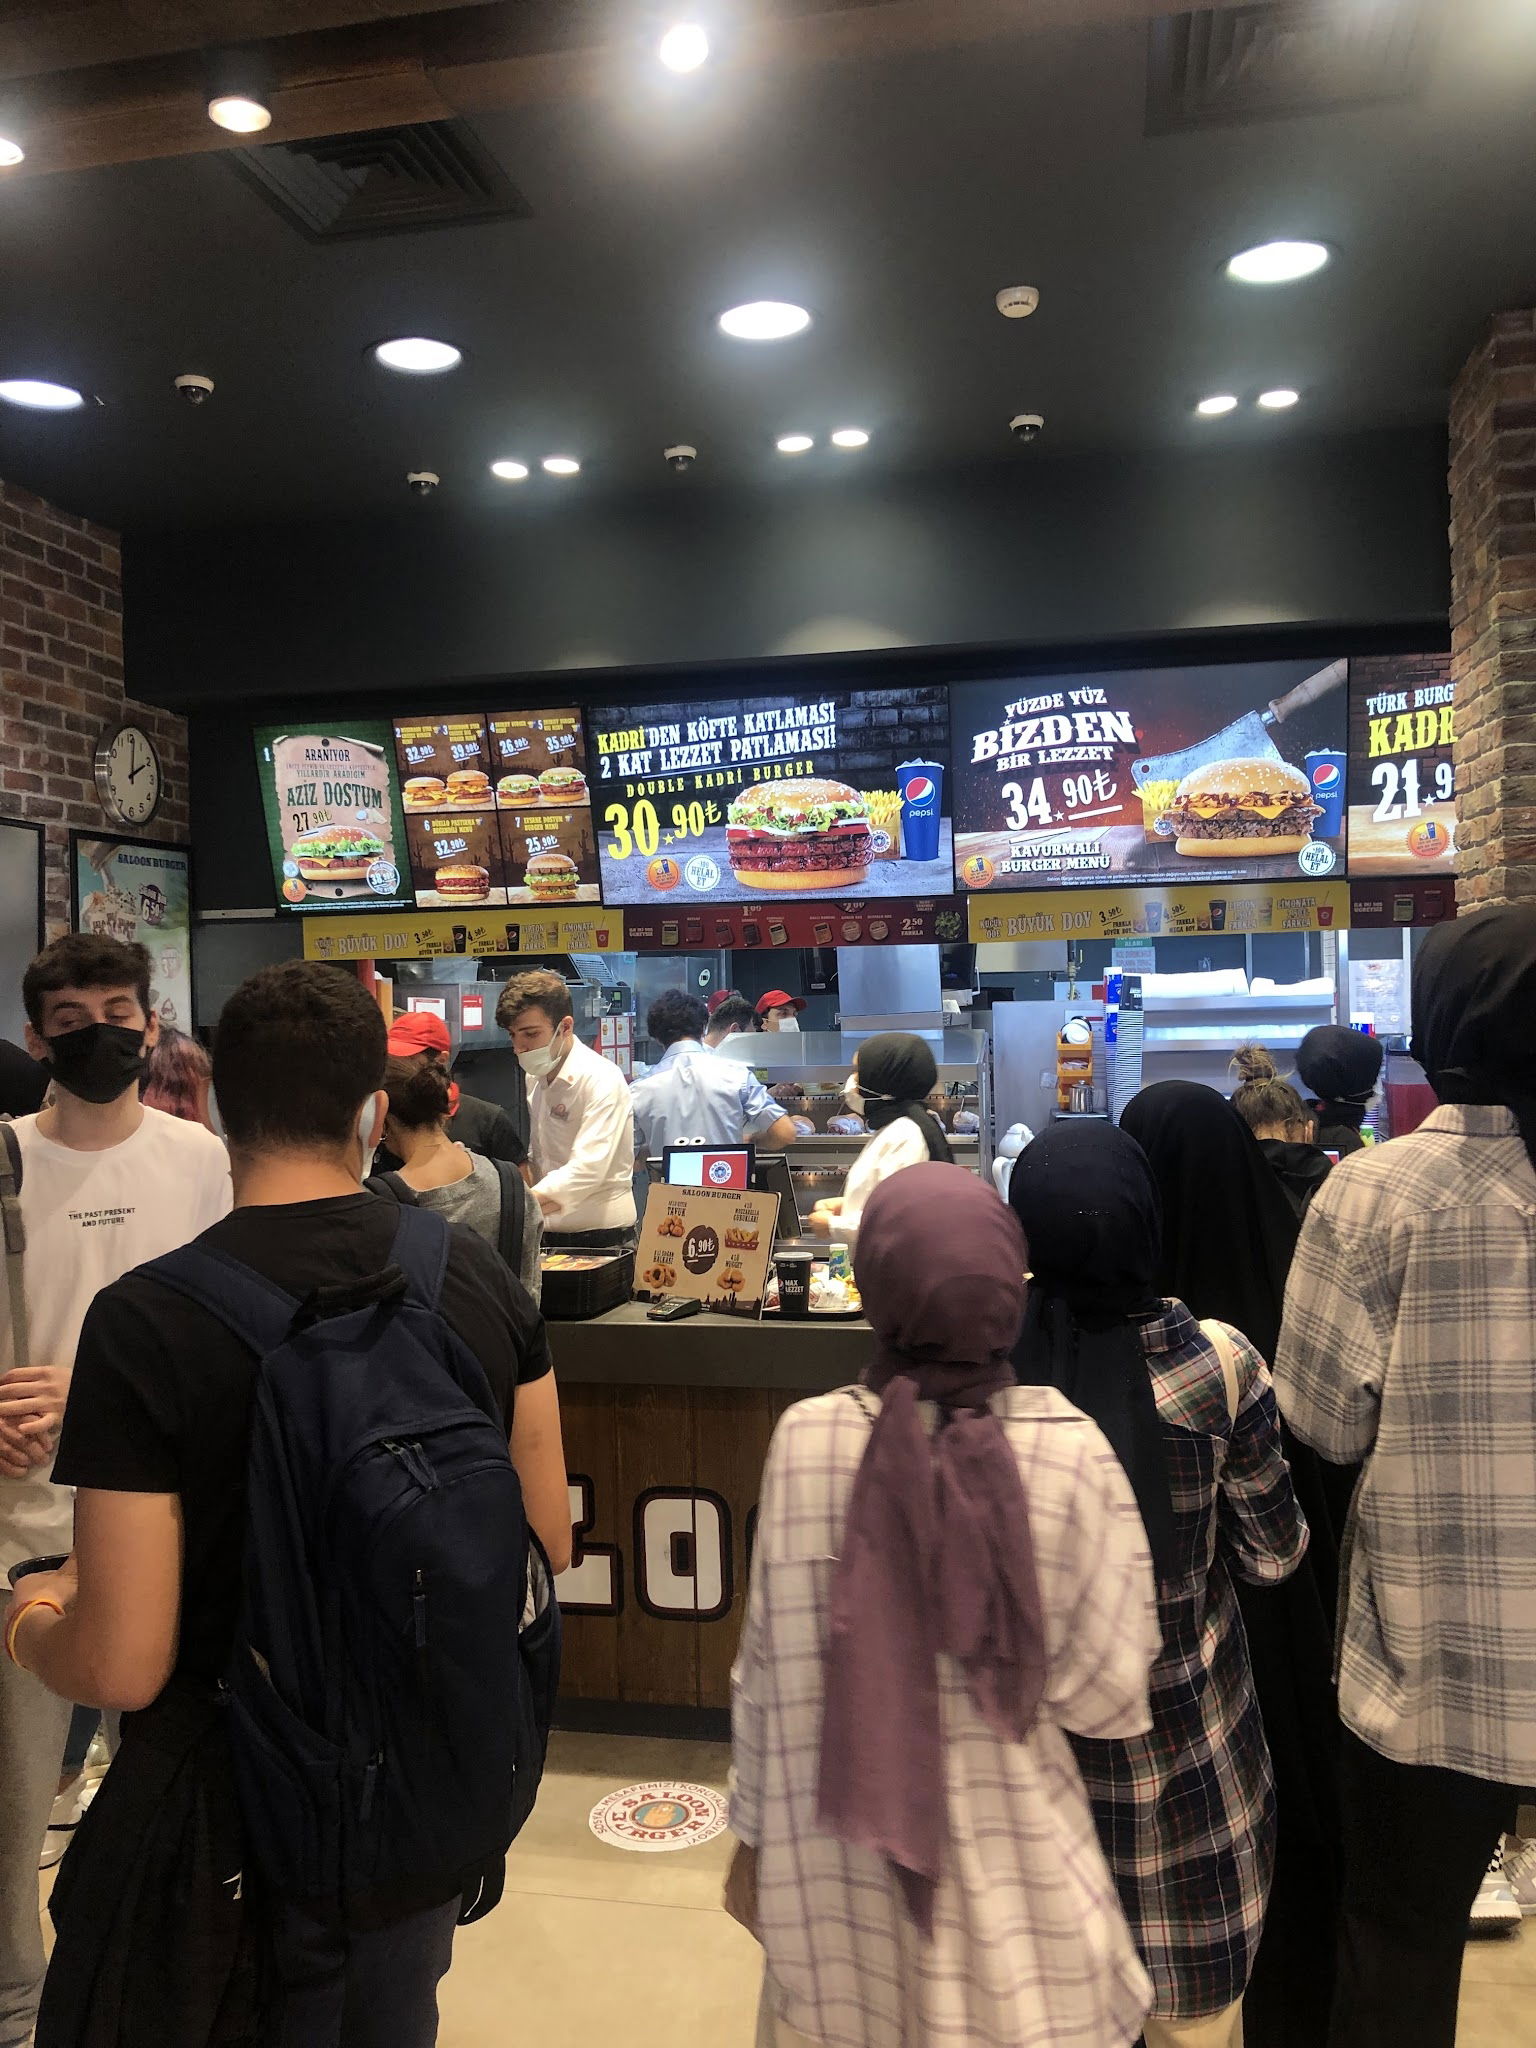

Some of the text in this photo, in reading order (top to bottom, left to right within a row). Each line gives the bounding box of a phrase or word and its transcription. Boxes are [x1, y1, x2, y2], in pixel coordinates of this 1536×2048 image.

[1004, 685, 1107, 718] YÜZDE YÜZ
[1366, 683, 1457, 716] TÜRK BURG
[538, 719, 543, 730] 5
[687, 714, 739, 744] KÖFTE
[744, 702, 836, 735] KATLAMASI
[396, 728, 401, 738] 2
[442, 725, 448, 736] 3
[971, 711, 1138, 764] BİZDEN
[305, 748, 350, 762] ARANIYOR
[600, 725, 838, 780] 2 KAT LEZZET PATLAMASI!
[996, 745, 1114, 773] BİR LEZZET
[146, 757, 151, 767] 2
[150, 775, 155, 785] 3
[626, 760, 815, 798] DOUBLE KADRİ BURGER
[146, 792, 151, 801] 4
[287, 779, 383, 809] AZİZ DOSTUM
[1315, 791, 1338, 800] pepsi
[129, 806, 135, 817] 6
[139, 803, 145, 813] 5
[424, 820, 430, 831] 6
[515, 817, 521, 829] 7
[1010, 841, 1102, 860] KAVURMALI
[1000, 856, 1062, 875] BURGER
[1066, 853, 1111, 870] MENÜ
[1305, 852, 1329, 864] HELAL
[691, 866, 714, 879] HELAL
[1007, 910, 1093, 936] BÜYÜK DOY
[383, 932, 409, 951] DOY
[682, 1188, 742, 1200] SALOON BURGER
[68, 1207, 136, 1220] THE PAST PRESENT
[82, 1217, 125, 1227] AND FUTURE
[622, 1791, 709, 1817] SALOON
